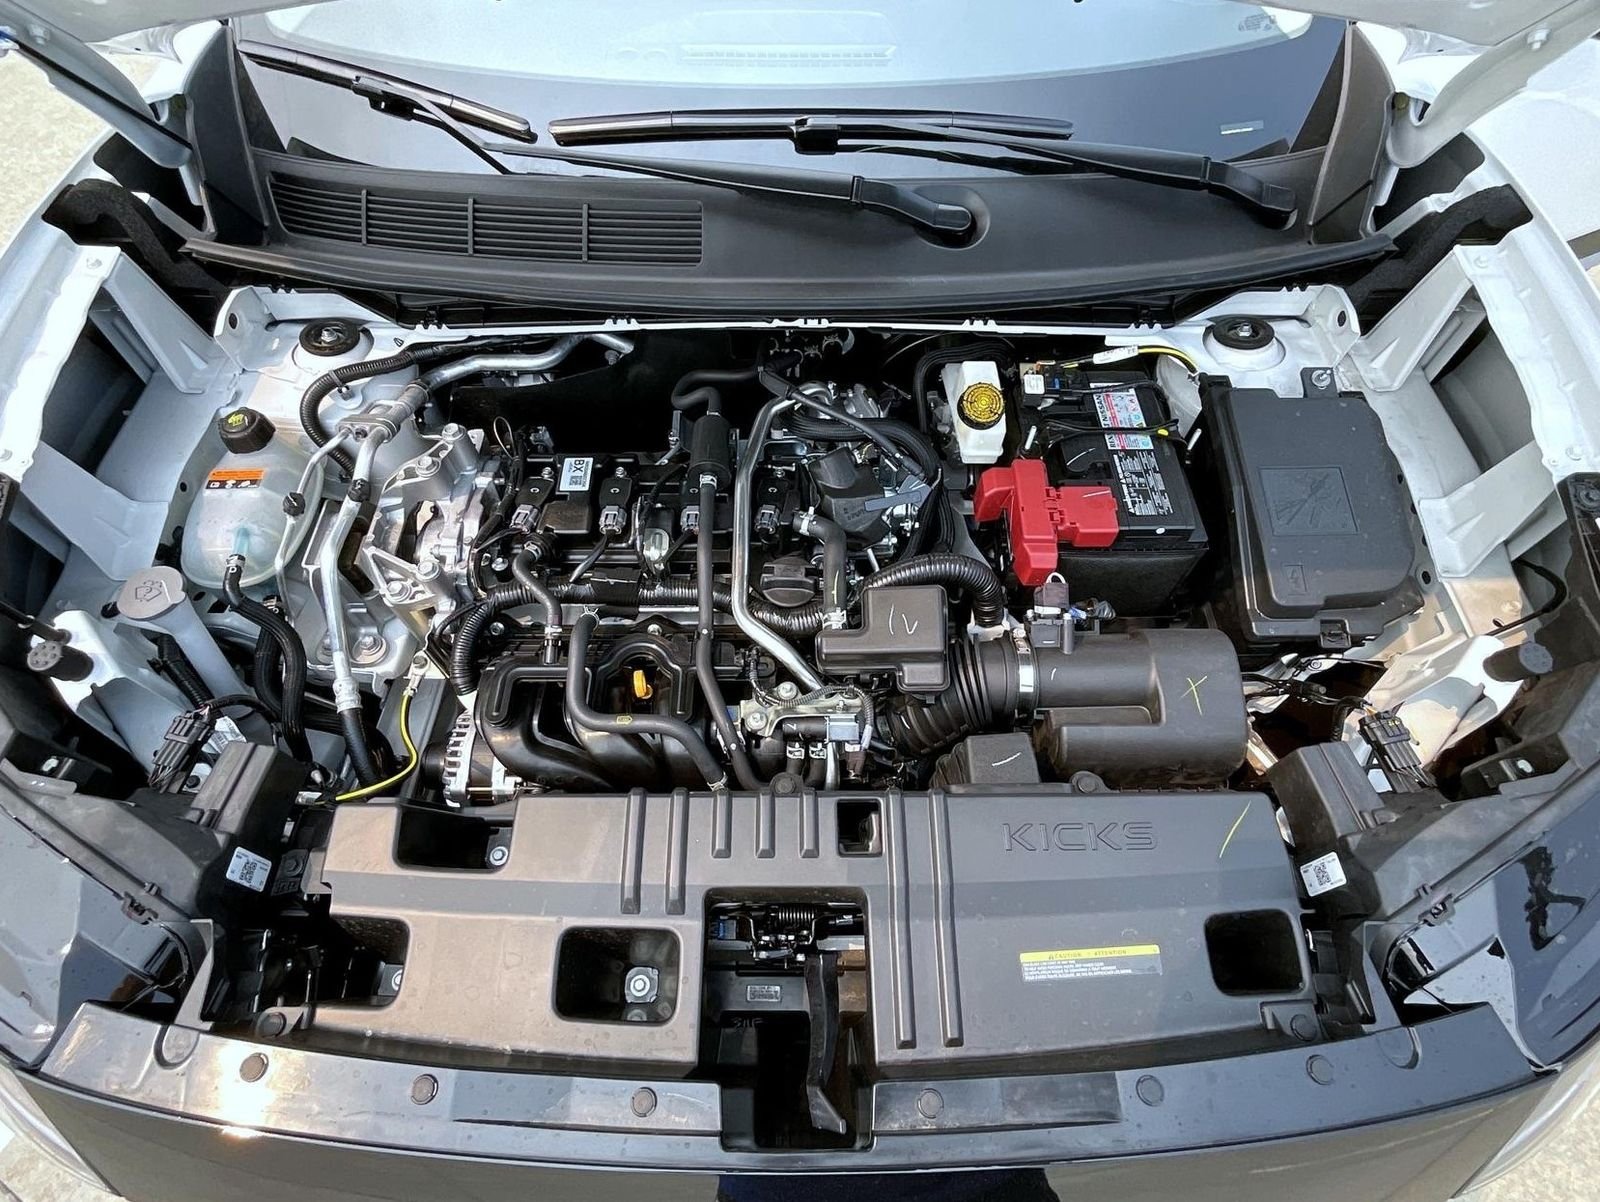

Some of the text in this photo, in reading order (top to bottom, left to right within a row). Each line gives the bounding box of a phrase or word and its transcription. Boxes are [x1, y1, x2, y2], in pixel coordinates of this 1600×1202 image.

[1095, 393, 1108, 421] NISSAN
[573, 460, 585, 472] BX
[1002, 822, 1158, 851] KICKS
